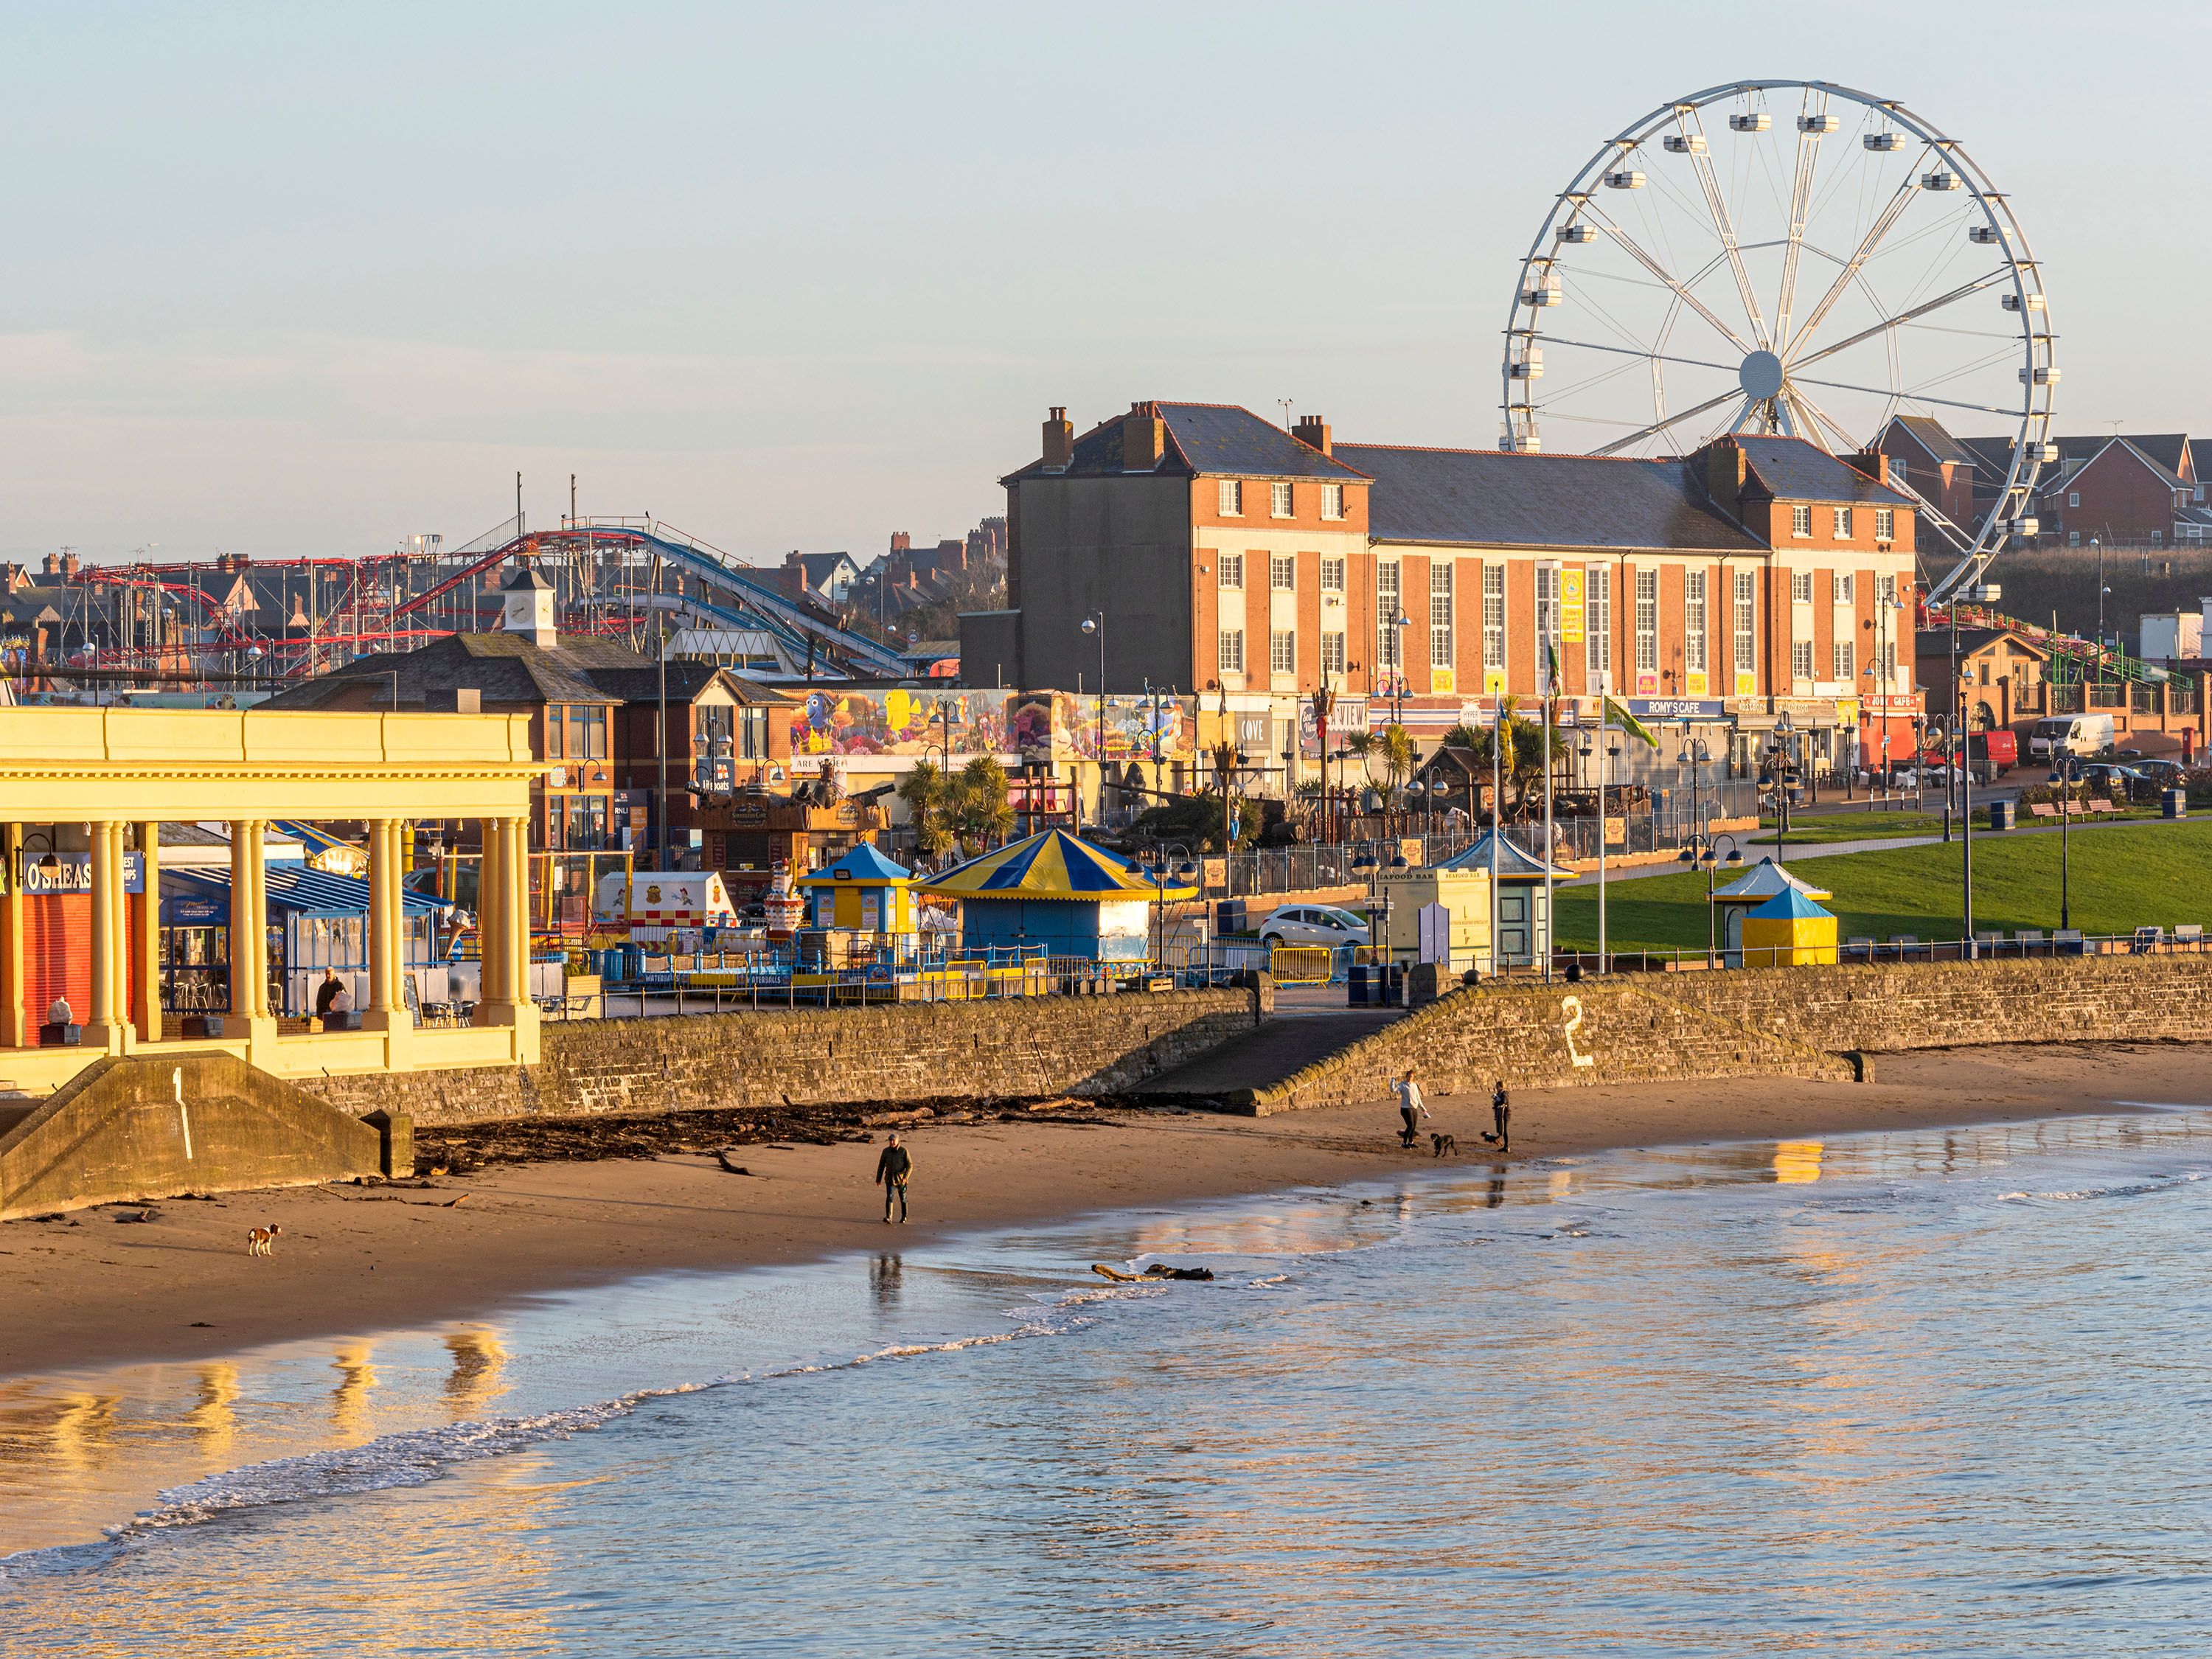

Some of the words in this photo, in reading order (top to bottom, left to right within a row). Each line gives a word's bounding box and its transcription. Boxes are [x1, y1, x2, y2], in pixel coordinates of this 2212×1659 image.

[1649, 701, 1678, 714] ROMY'S
[1678, 702, 1700, 714] CAFE
[1784, 700, 1809, 713] Jackson
[1893, 696, 1910, 706] CAFE
[1302, 711, 1312, 723] Sea
[1340, 706, 1363, 726] VIEW
[1241, 719, 1264, 741] COVE
[645, 973, 680, 982] WATERBALS
[748, 975, 781, 984] ATERBALLS
[1562, 995, 1593, 1067] 2
